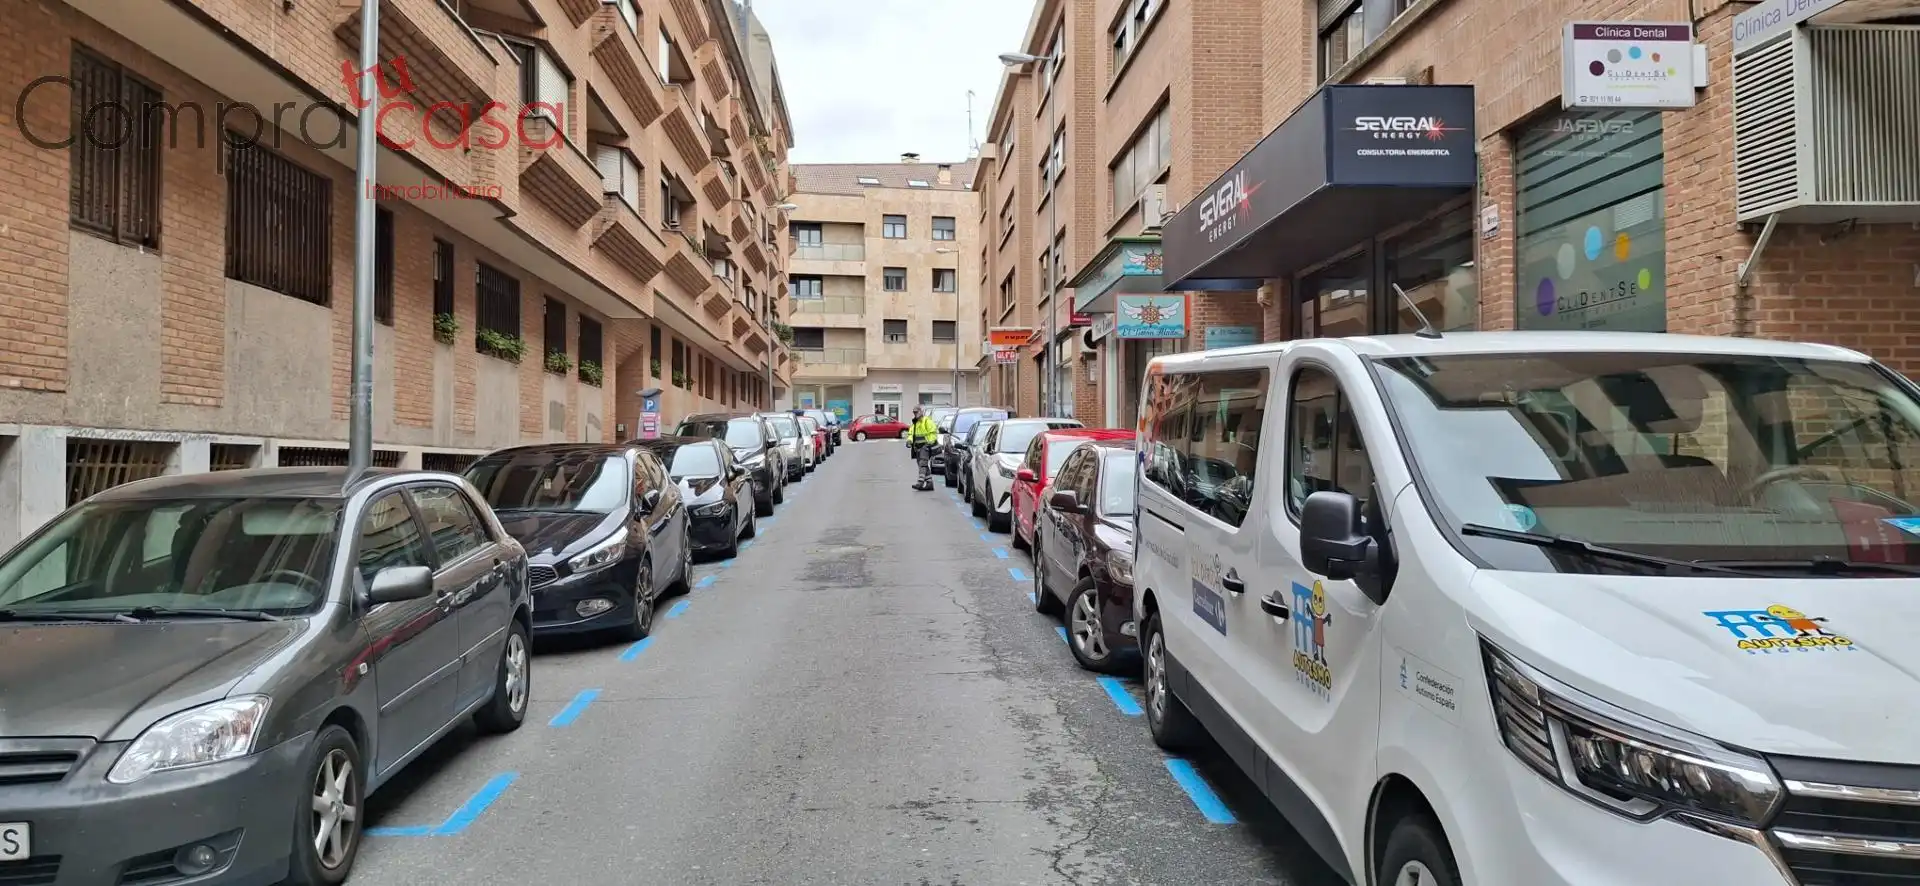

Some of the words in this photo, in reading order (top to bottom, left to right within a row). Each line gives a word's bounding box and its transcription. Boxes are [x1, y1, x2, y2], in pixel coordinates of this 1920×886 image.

[1634, 28, 1667, 38] Dental
[1355, 116, 1439, 131] SEVERAL
[1200, 170, 1248, 232] SEVERAL
[1209, 212, 1237, 243] ENERGY
[646, 400, 654, 411] P
[1738, 636, 1853, 650] AUTISMO
[1293, 649, 1331, 690] AUTISMO
